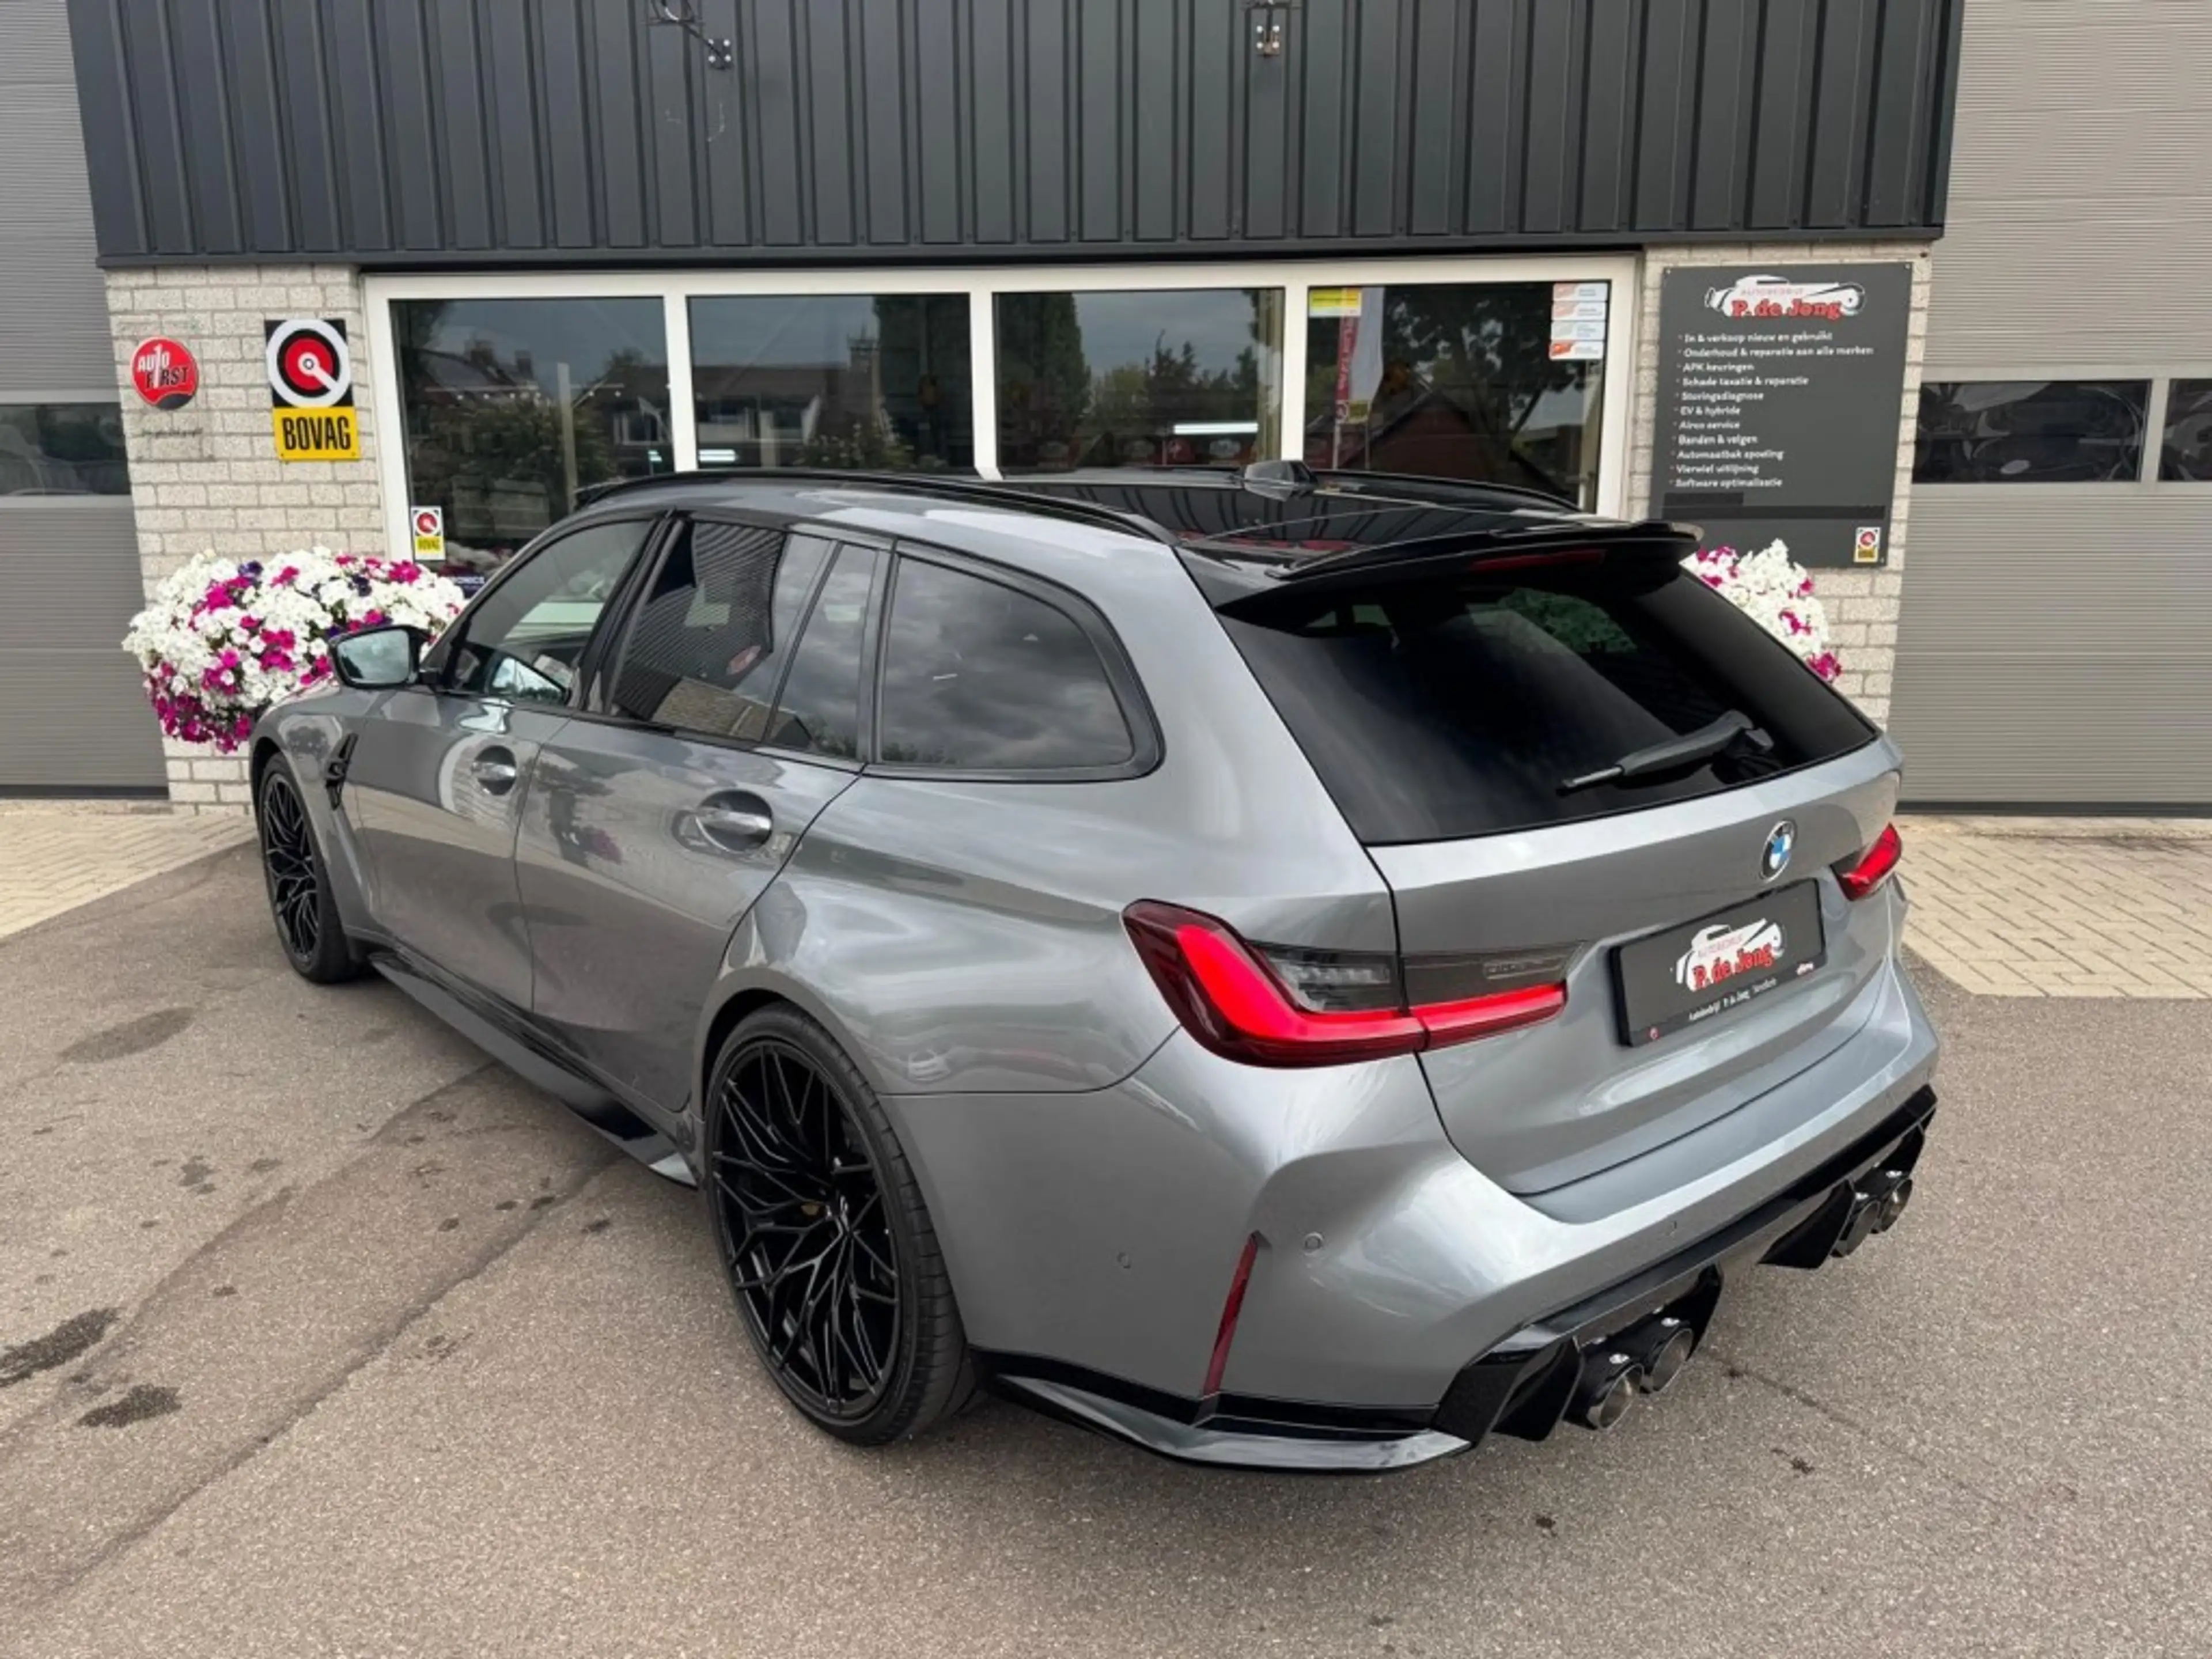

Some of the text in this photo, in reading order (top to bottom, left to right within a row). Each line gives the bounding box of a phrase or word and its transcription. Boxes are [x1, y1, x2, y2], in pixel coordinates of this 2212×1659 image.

[1731, 298, 1842, 320] P. de Jong
[1684, 334, 1696, 343] In
[1698, 334, 1705, 343] &
[1707, 334, 1746, 344] verkoop
[1748, 333, 1775, 342] nieuw
[1791, 331, 1833, 343] gebruikt
[1683, 347, 1738, 358] Onderhoud
[1740, 347, 1748, 357] &
[1750, 347, 1794, 358] reparatie
[1816, 346, 1834, 355] alle
[1836, 346, 1874, 355] merken
[1683, 362, 1755, 373] APK keuringen
[1683, 376, 1809, 388] Schade taxatie & reparatie
[1681, 391, 1764, 403] Storingsdiagnose
[1680, 405, 1741, 418] EV & hybride
[1679, 419, 1741, 430] Airco service
[281, 416, 351, 451] BOVAG
[1678, 433, 1758, 446] Banden & velgen
[1677, 449, 1784, 461] Automaatbak spoeling
[1676, 463, 1760, 475] Vierwiel uitlijning
[1676, 477, 1783, 489] Software optimalisatie
[1692, 964, 1714, 990] P.
[1713, 957, 1730, 984] de
[1733, 944, 1773, 974] Jong
